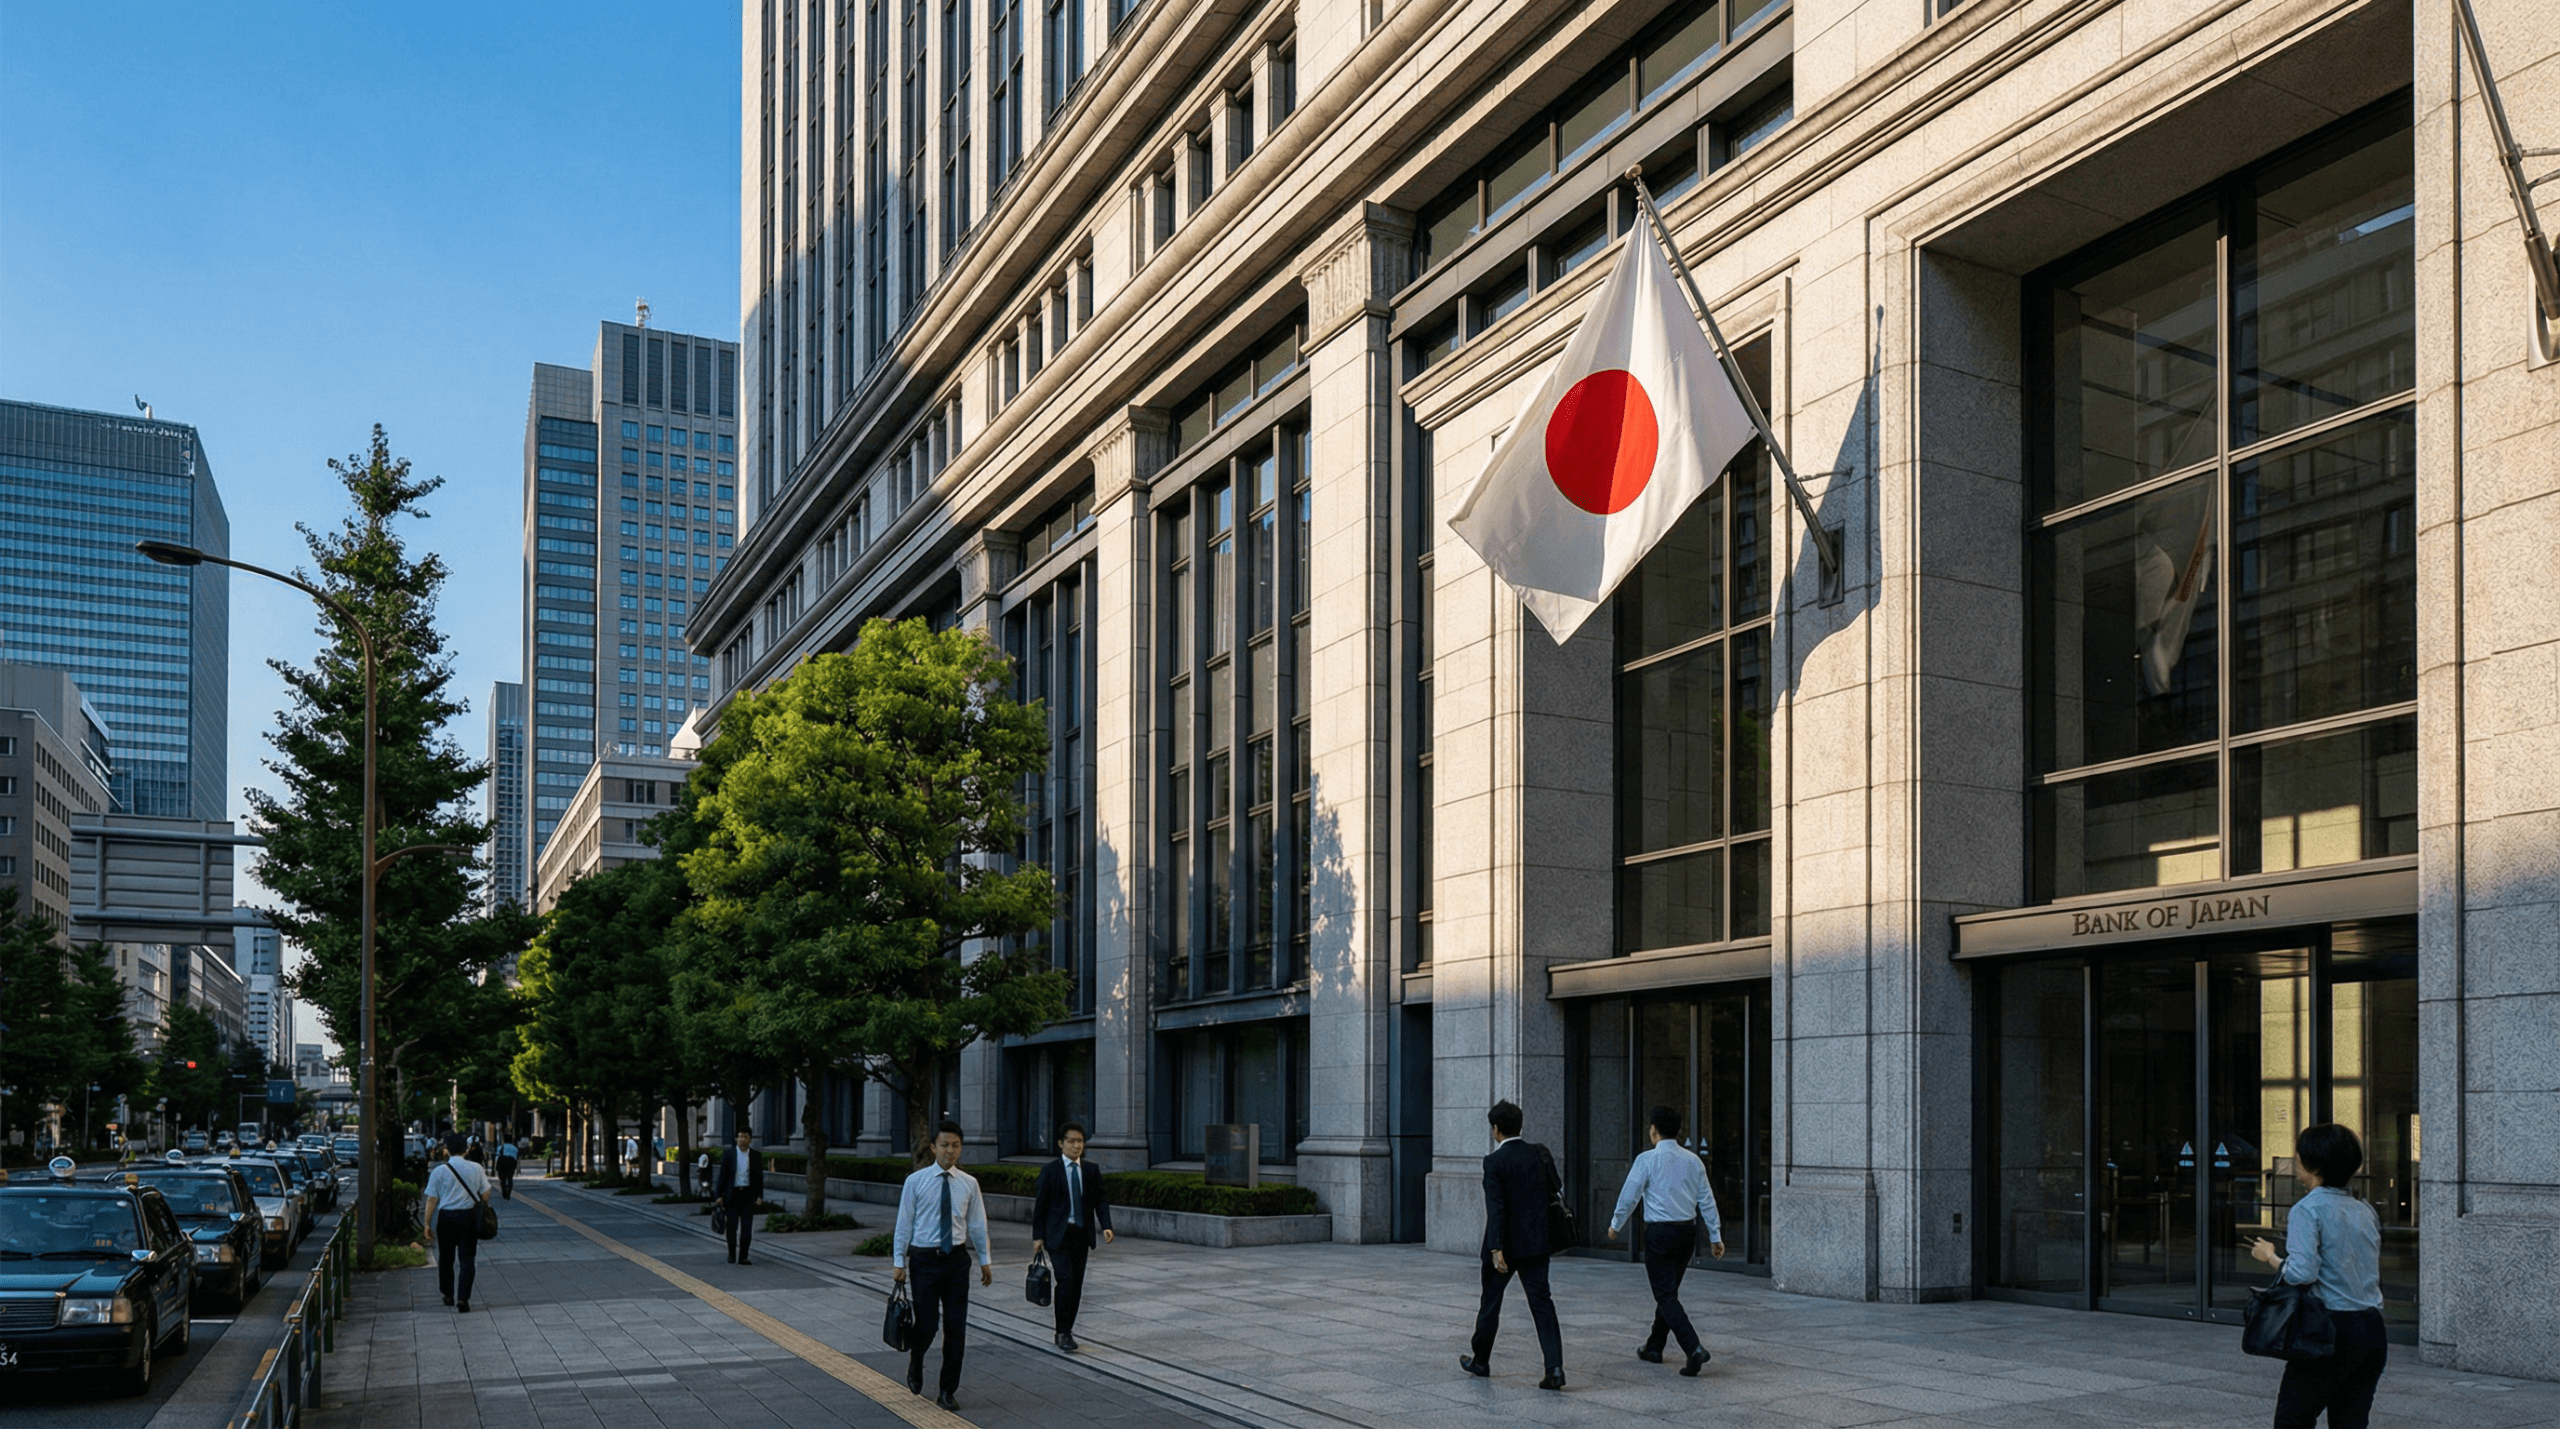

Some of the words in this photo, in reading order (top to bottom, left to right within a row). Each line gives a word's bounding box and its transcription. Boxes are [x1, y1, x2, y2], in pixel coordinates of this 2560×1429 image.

[2071, 909, 2141, 936] BANK
[2146, 905, 2179, 929] OF
[2185, 895, 2271, 930] JAPAN
